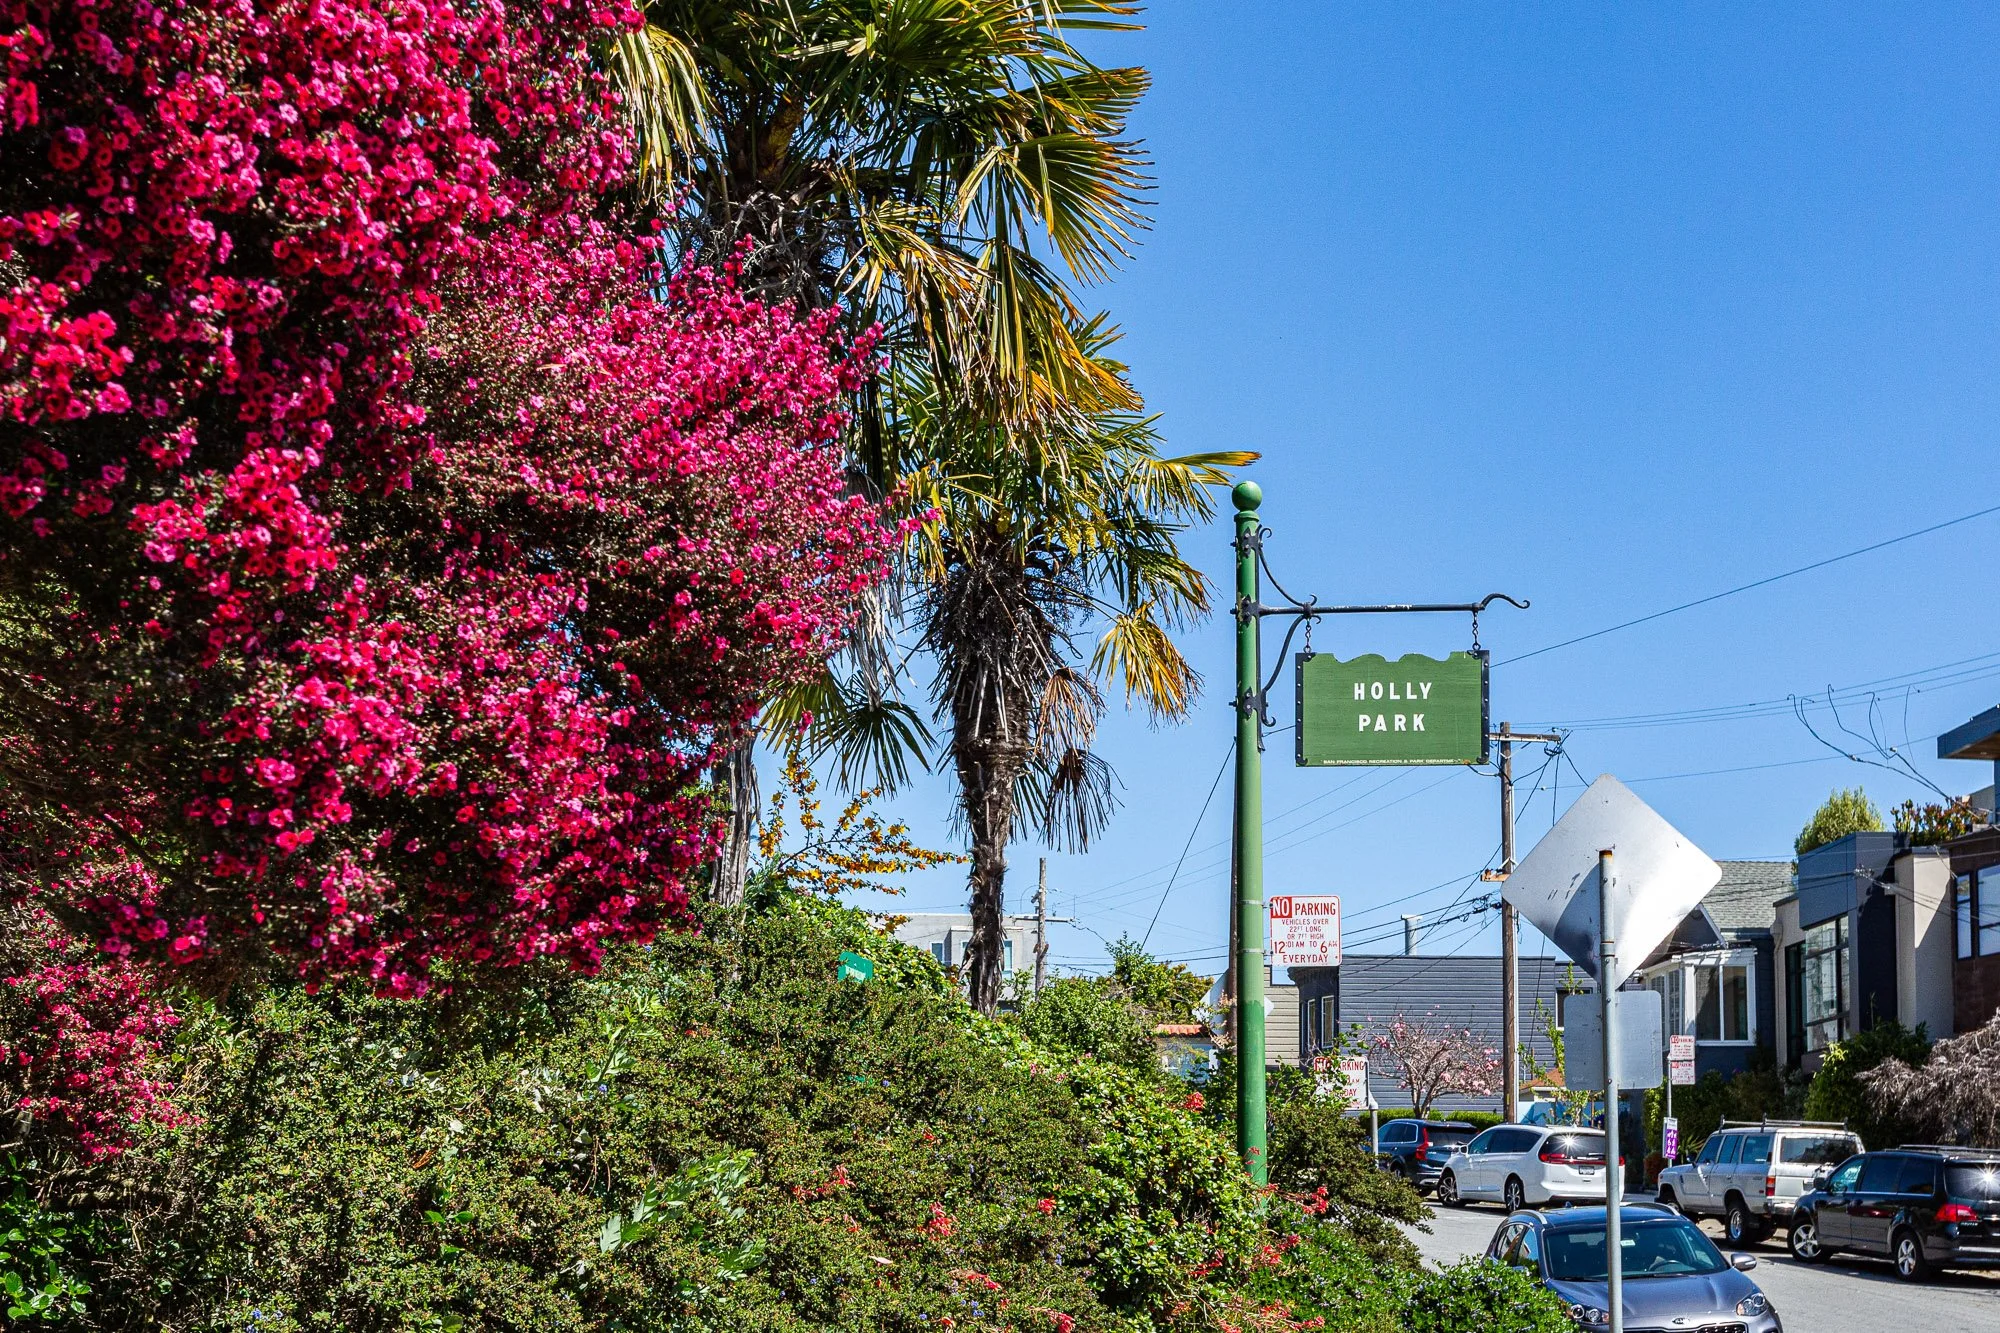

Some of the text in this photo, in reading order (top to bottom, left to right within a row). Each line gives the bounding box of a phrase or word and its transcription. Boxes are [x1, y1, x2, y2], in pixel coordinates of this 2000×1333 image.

[1354, 682, 1432, 700] HOLLY
[1358, 714, 1426, 732] PARK
[1272, 898, 1336, 917] NO PARKING
[1305, 925, 1322, 933] LONG
[1309, 940, 1318, 948] TO
[1282, 954, 1329, 964] EVERYDAY
